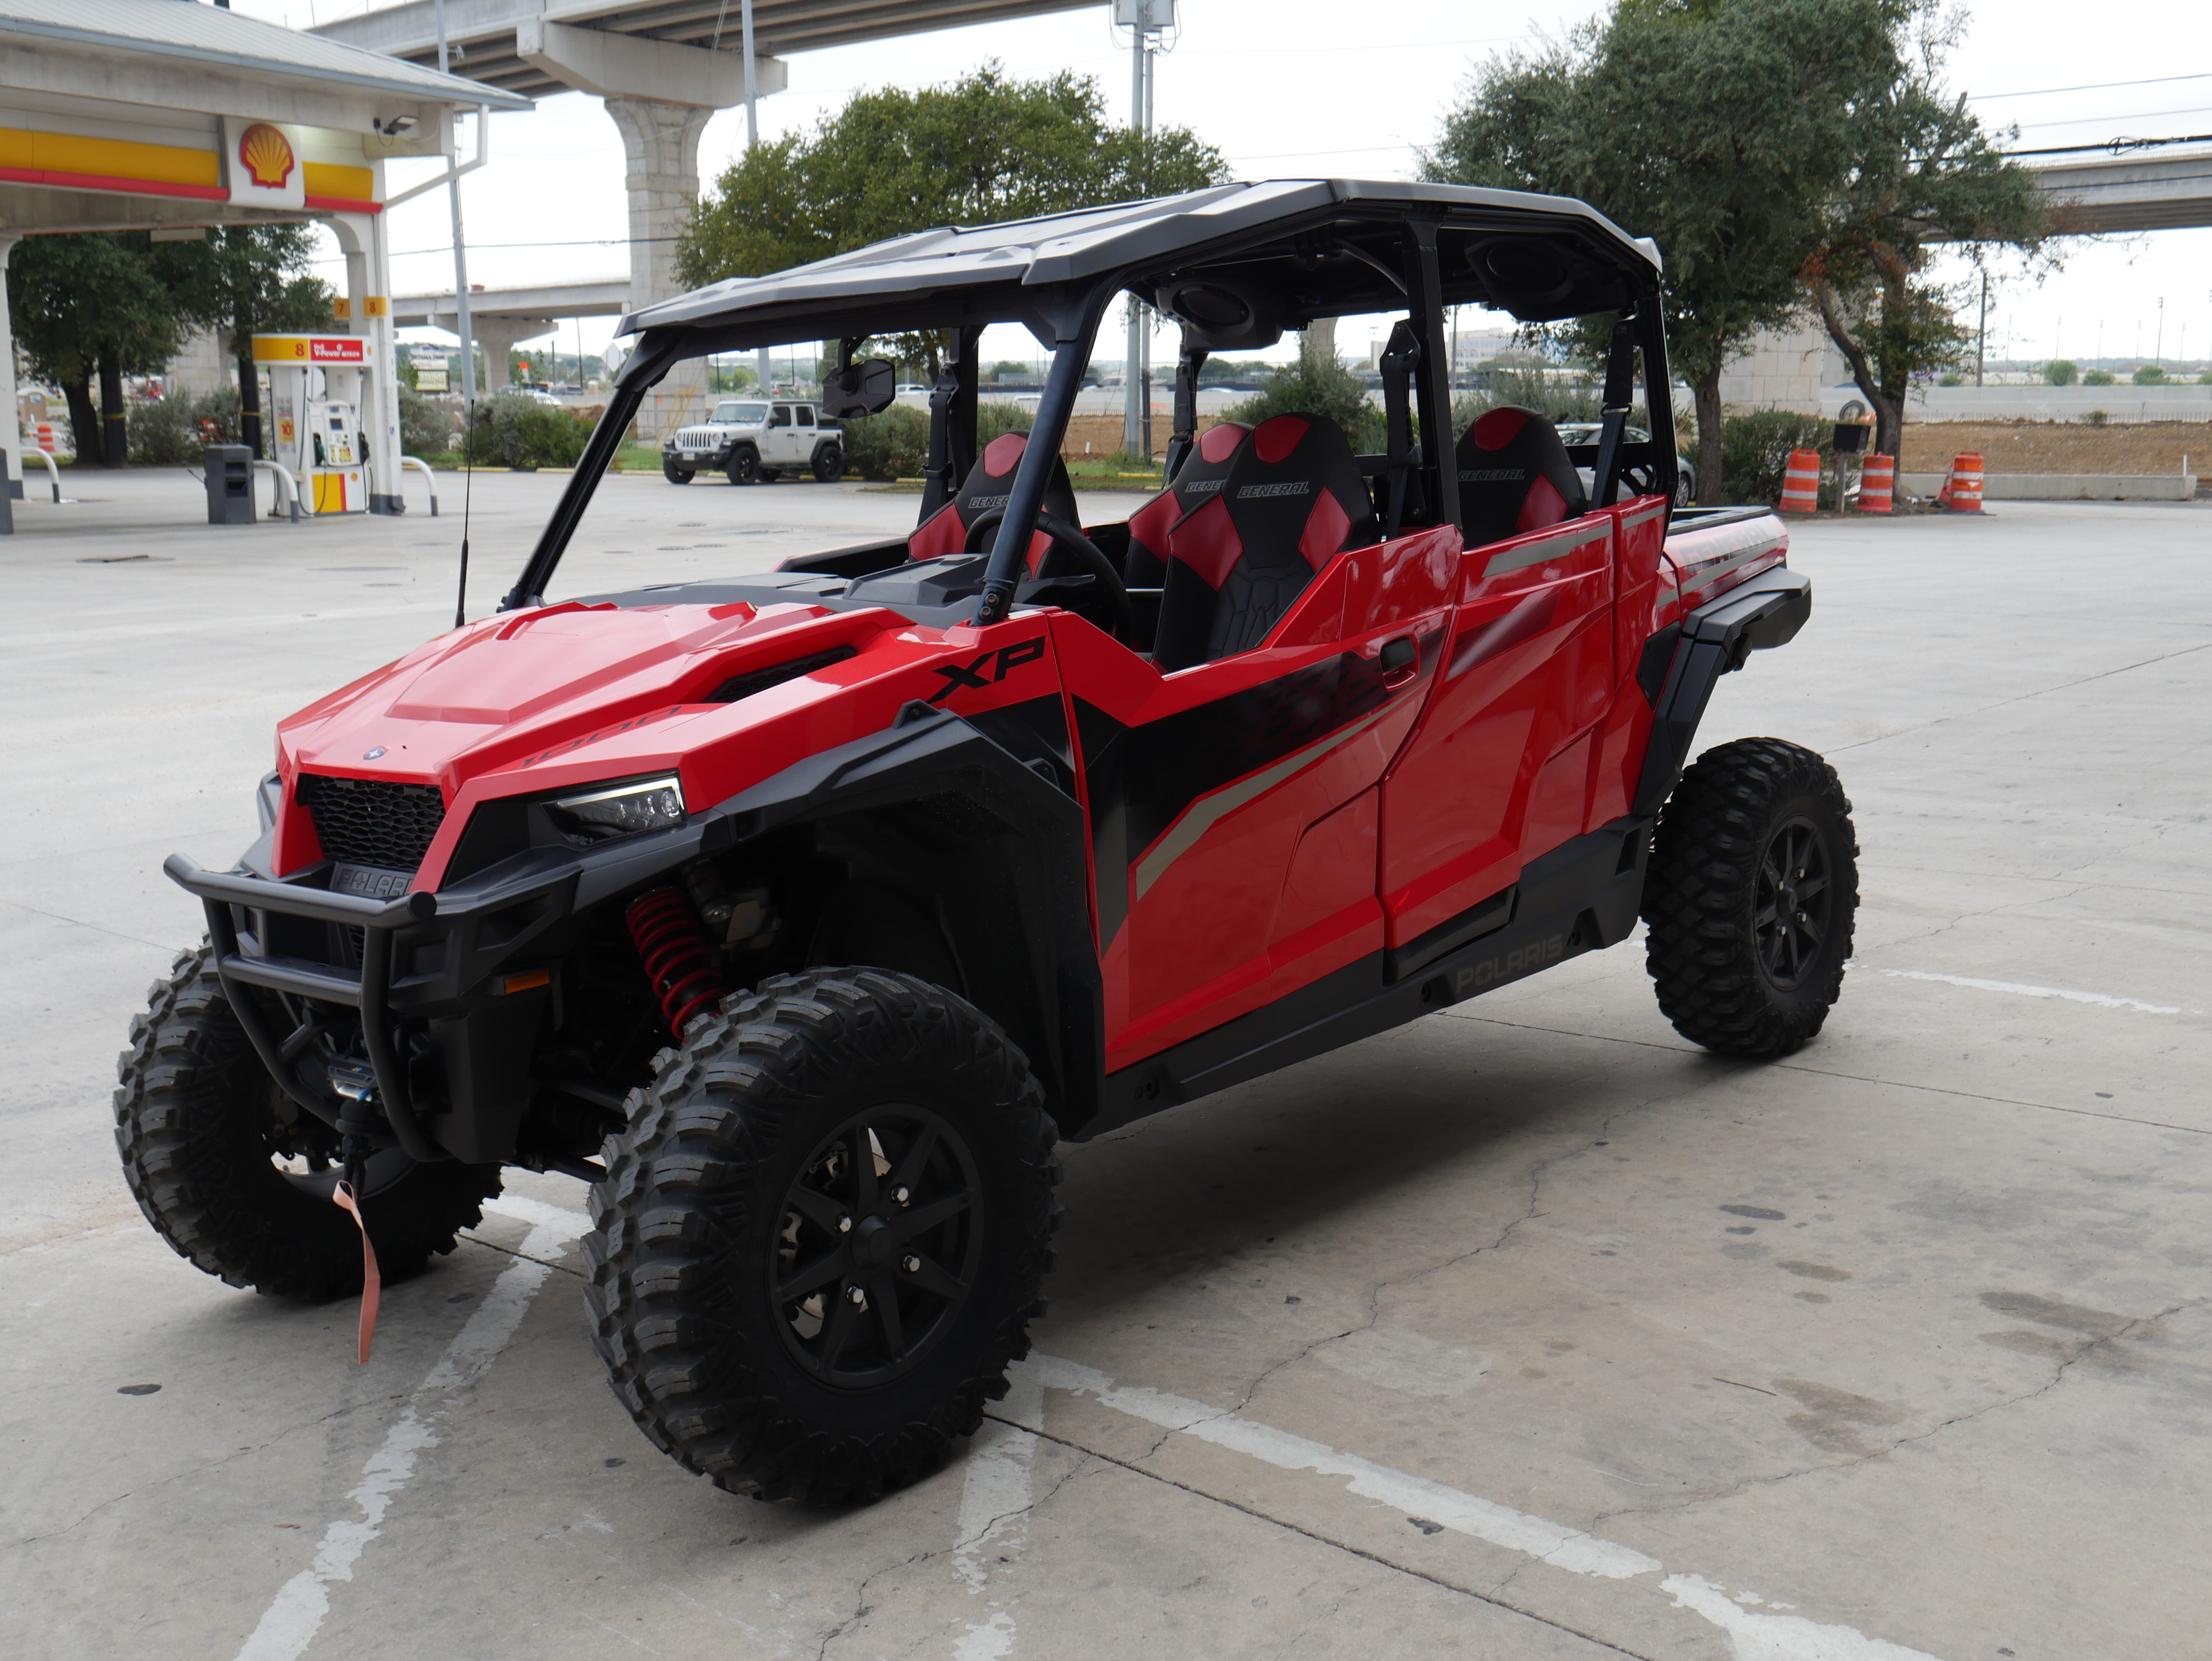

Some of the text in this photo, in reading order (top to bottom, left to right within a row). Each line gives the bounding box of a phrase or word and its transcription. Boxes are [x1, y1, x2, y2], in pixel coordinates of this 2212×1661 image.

[338, 303, 344, 314] 7
[369, 301, 376, 314] 8
[295, 343, 304, 357] 8
[1457, 469, 1525, 481] GENERAL
[1185, 481, 1227, 493] GENE
[1237, 481, 1310, 499] GENERAL
[1679, 524, 1777, 575] GENERAL
[925, 634, 1047, 705] XP
[521, 705, 682, 768] 1000
[1456, 934, 1565, 995] POLARIS
